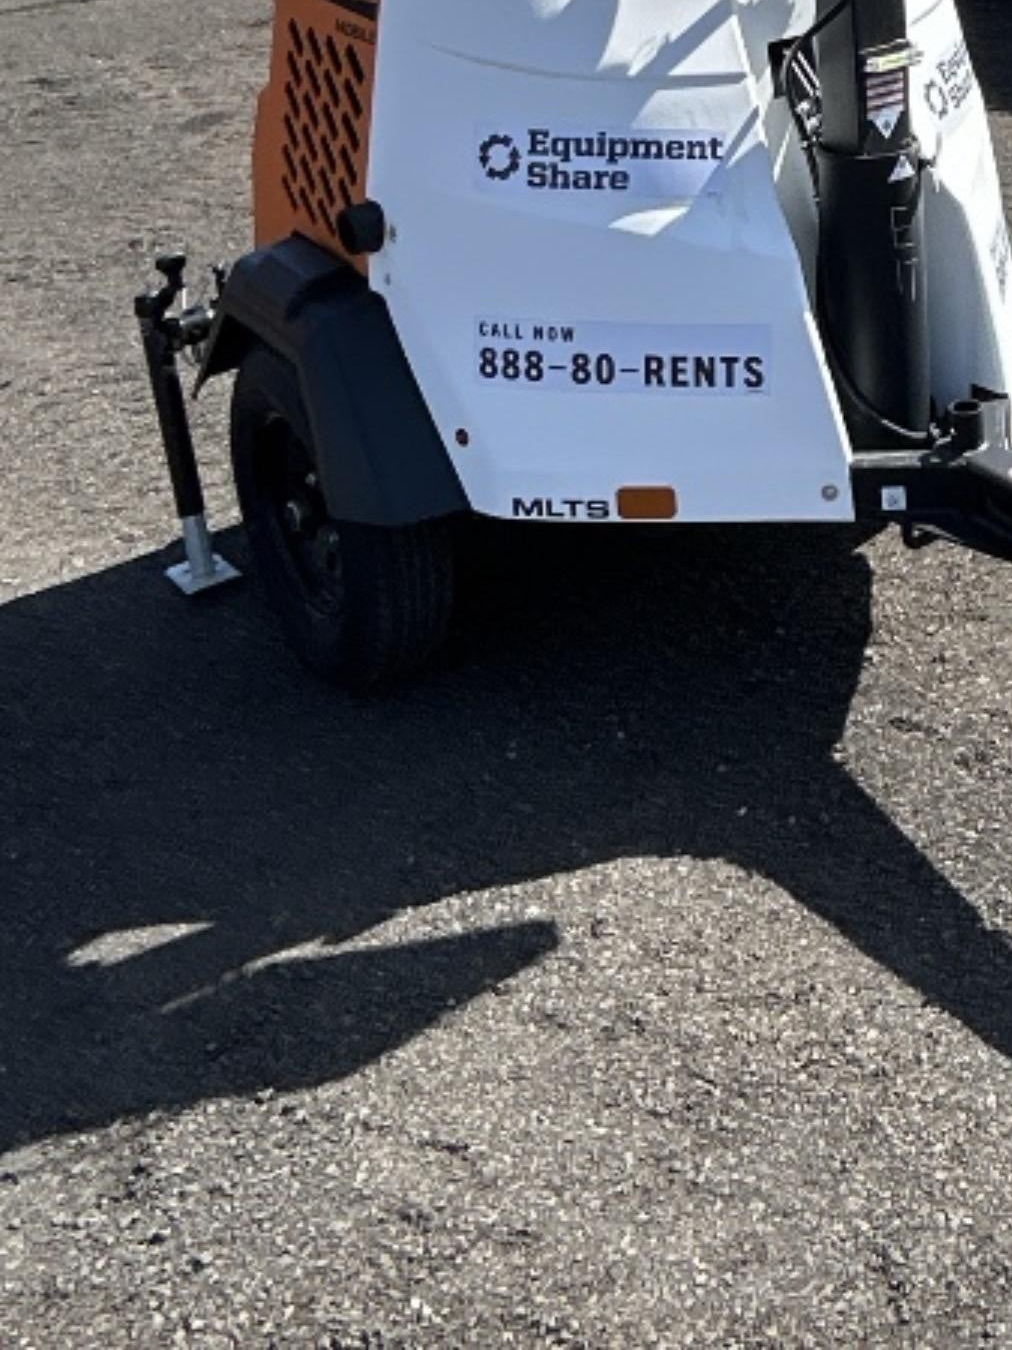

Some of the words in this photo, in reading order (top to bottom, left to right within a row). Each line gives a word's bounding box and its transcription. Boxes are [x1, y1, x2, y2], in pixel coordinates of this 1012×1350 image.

[527, 129, 724, 164] Equipment
[527, 162, 630, 189] Share
[479, 321, 523, 340] CALL
[533, 326, 575, 342] NOW
[479, 346, 765, 388] 888-80-RENTS
[512, 497, 610, 519] MLTS
